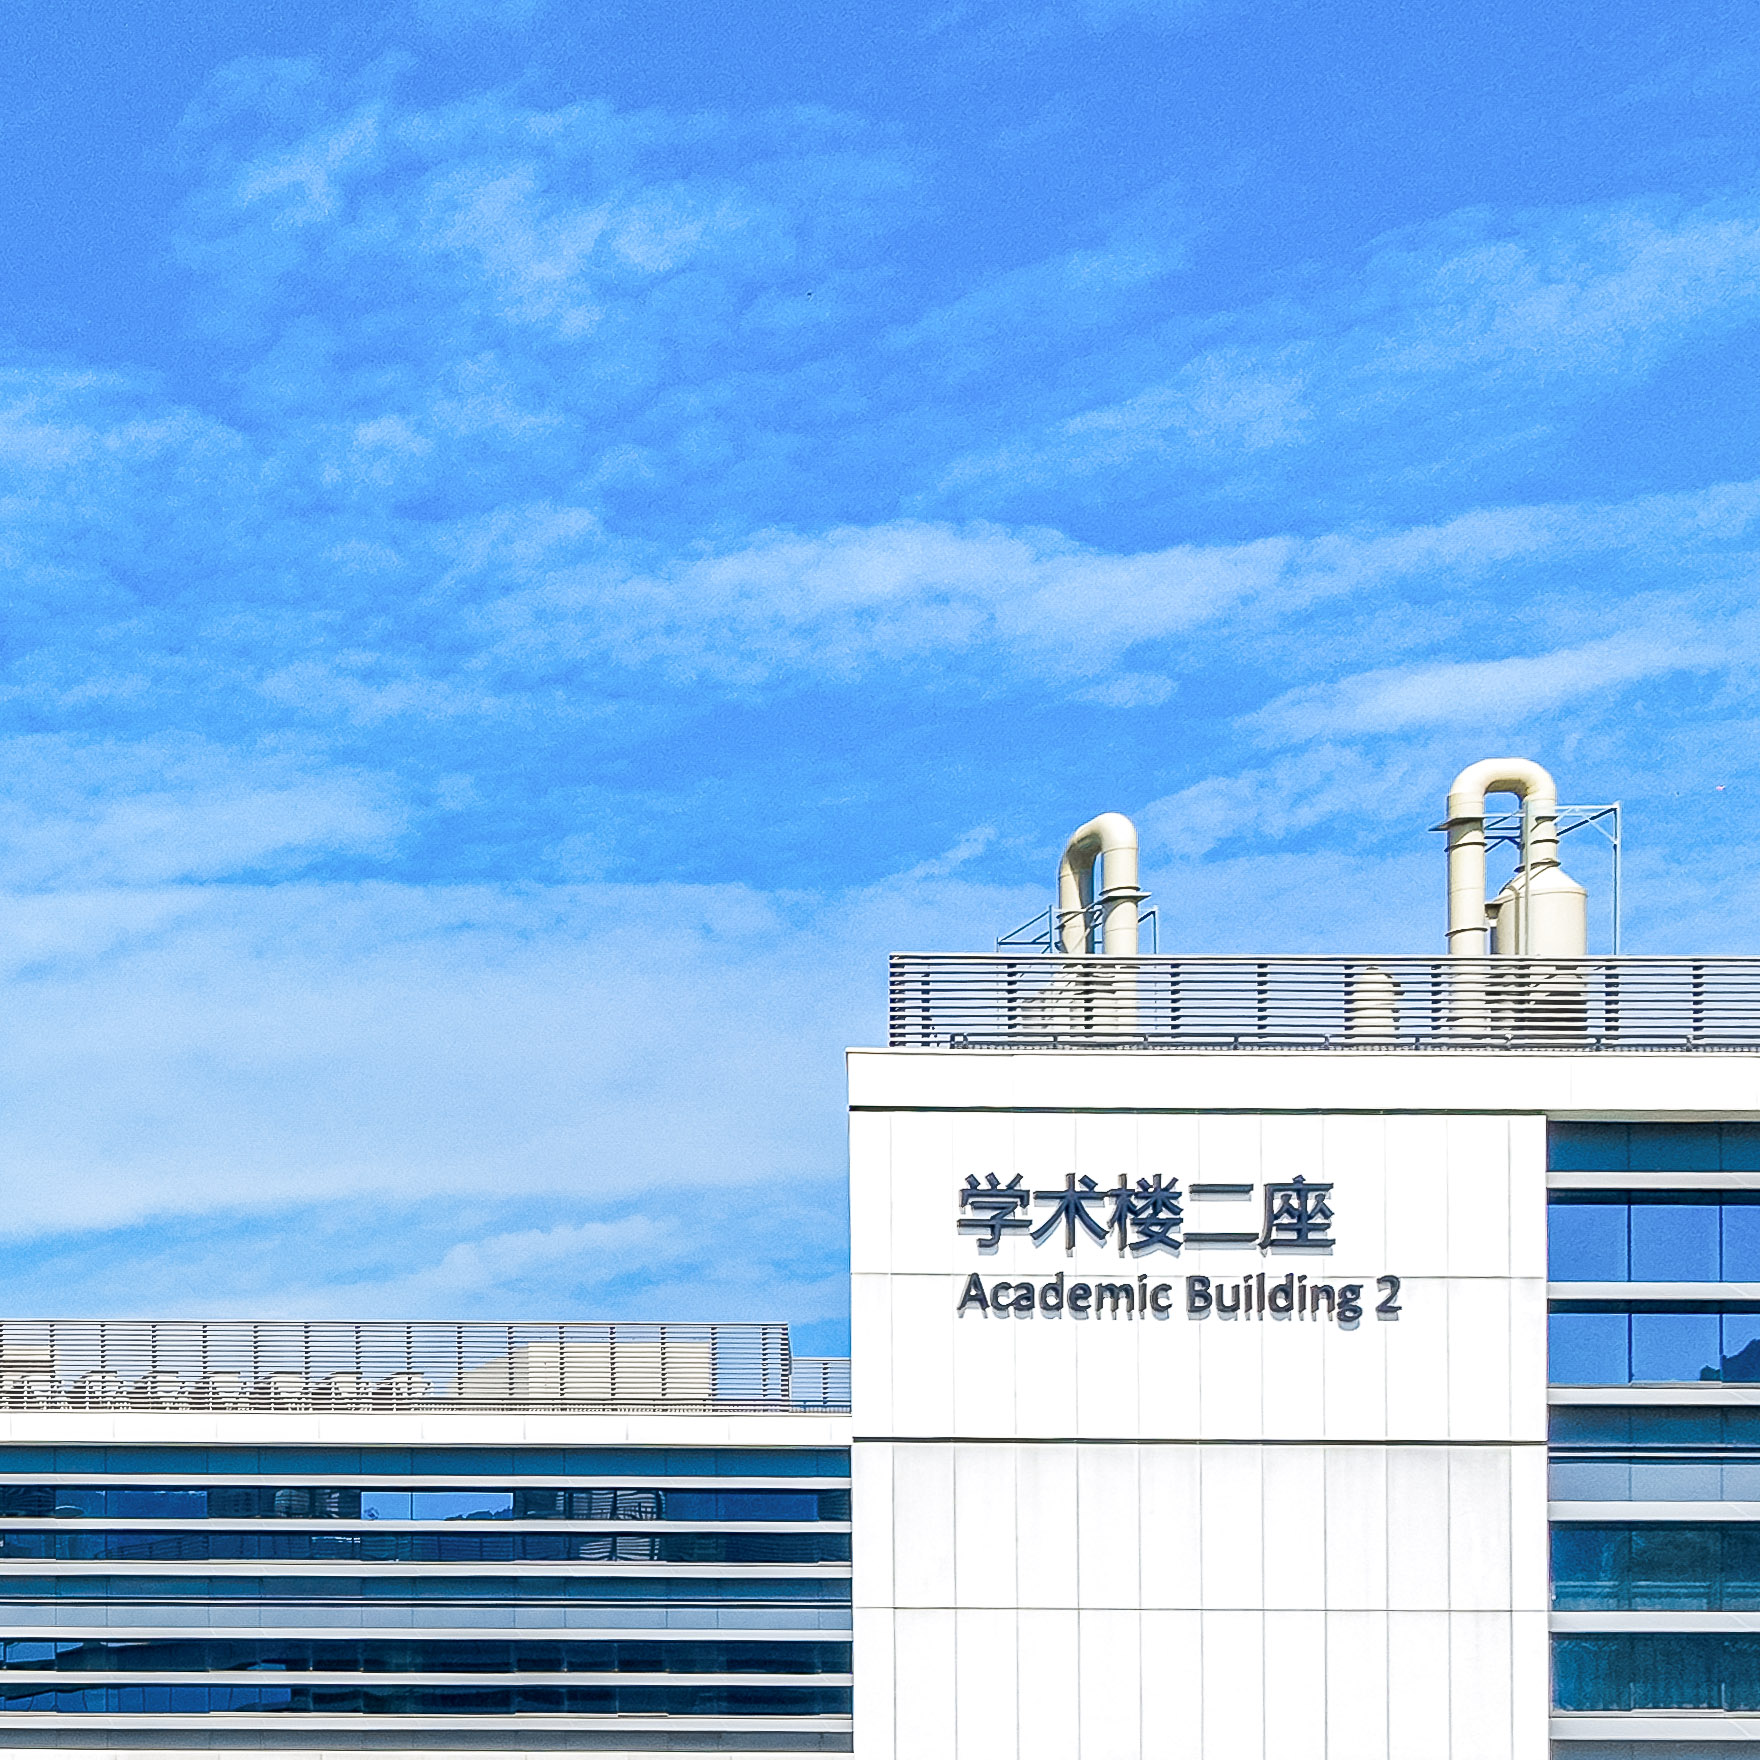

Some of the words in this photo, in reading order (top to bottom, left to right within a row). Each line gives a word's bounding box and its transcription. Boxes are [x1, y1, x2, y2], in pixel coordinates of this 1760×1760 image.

[957, 1173, 1336, 1252] 学术楼二座
[957, 1272, 1173, 1314] Academic
[1186, 1273, 1364, 1323] Building
[1376, 1275, 1402, 1315] 2
